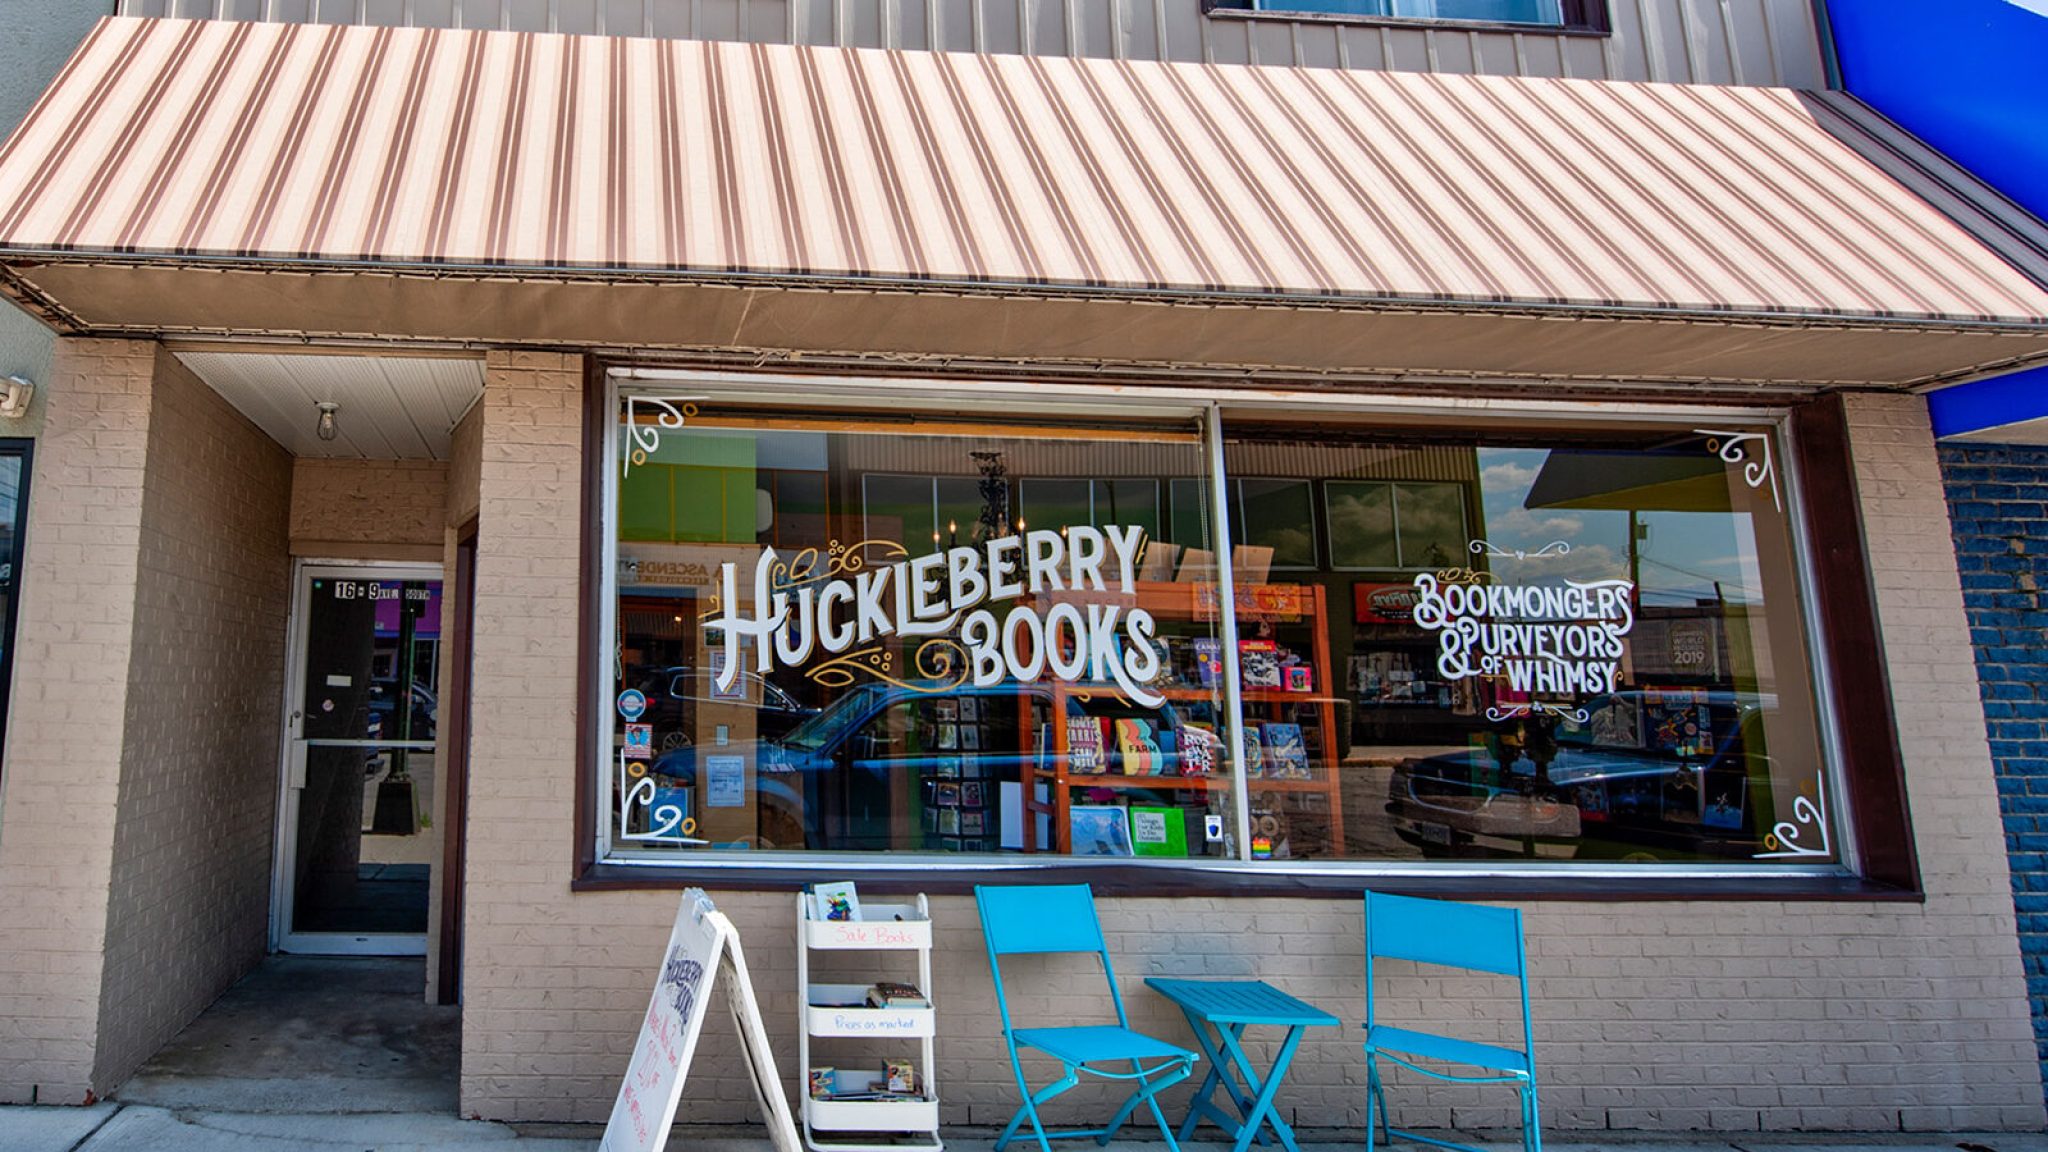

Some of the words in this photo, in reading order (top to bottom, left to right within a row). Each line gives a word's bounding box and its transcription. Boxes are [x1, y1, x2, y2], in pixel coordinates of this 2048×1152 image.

[703, 525, 1144, 692] HUCKLEBERRY
[1413, 573, 1634, 636] BOOKMONGERS
[961, 603, 1167, 708] BOOKS
[1437, 628, 1482, 680] &
[1455, 616, 1624, 662] PURVEYORS
[1673, 651, 1706, 665] 2019
[1481, 655, 1503, 675] OF
[1504, 659, 1618, 693] WHIMSY
[1128, 744, 1158, 754] FARM
[835, 925, 867, 943] Sale
[873, 926, 914, 944] Books
[835, 1014, 862, 1029] Prices
[864, 1019, 877, 1029] as
